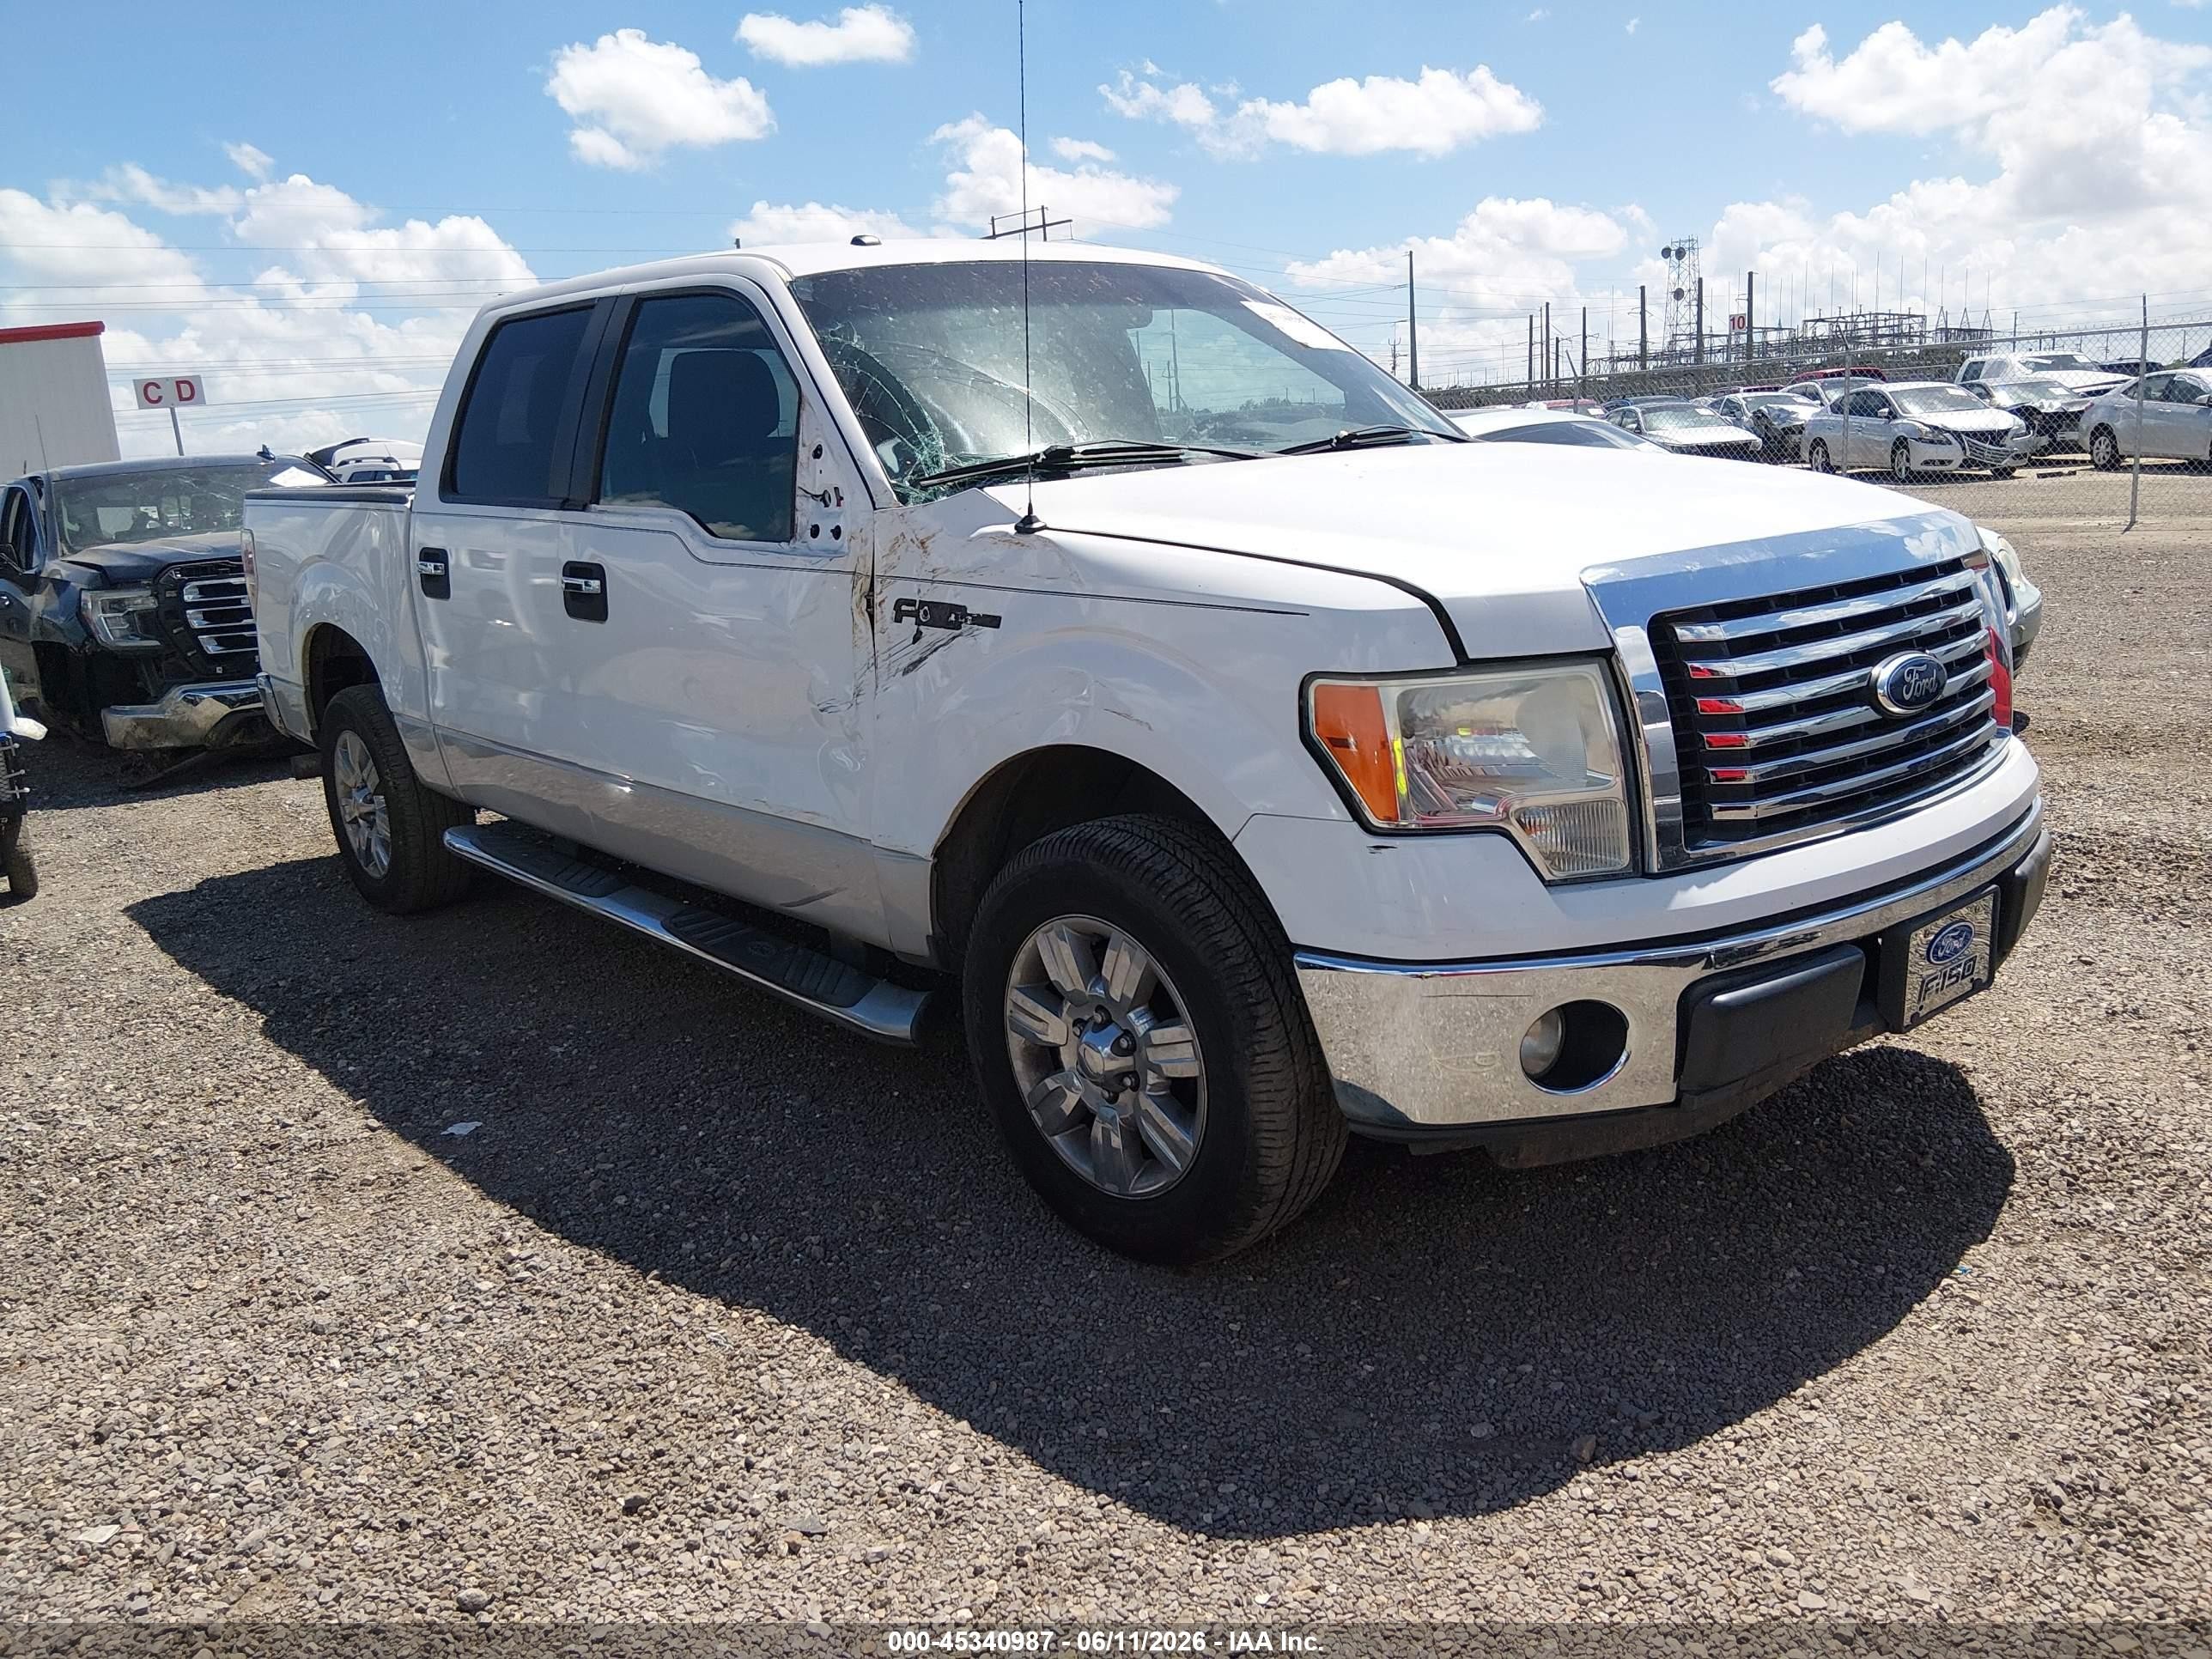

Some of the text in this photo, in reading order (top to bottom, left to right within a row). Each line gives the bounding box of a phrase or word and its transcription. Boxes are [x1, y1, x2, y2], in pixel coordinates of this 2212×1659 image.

[1729, 315, 1745, 330] 10
[143, 380, 196, 404] C D
[1902, 664, 1938, 701] Ford
[1937, 930, 1966, 957] Ford
